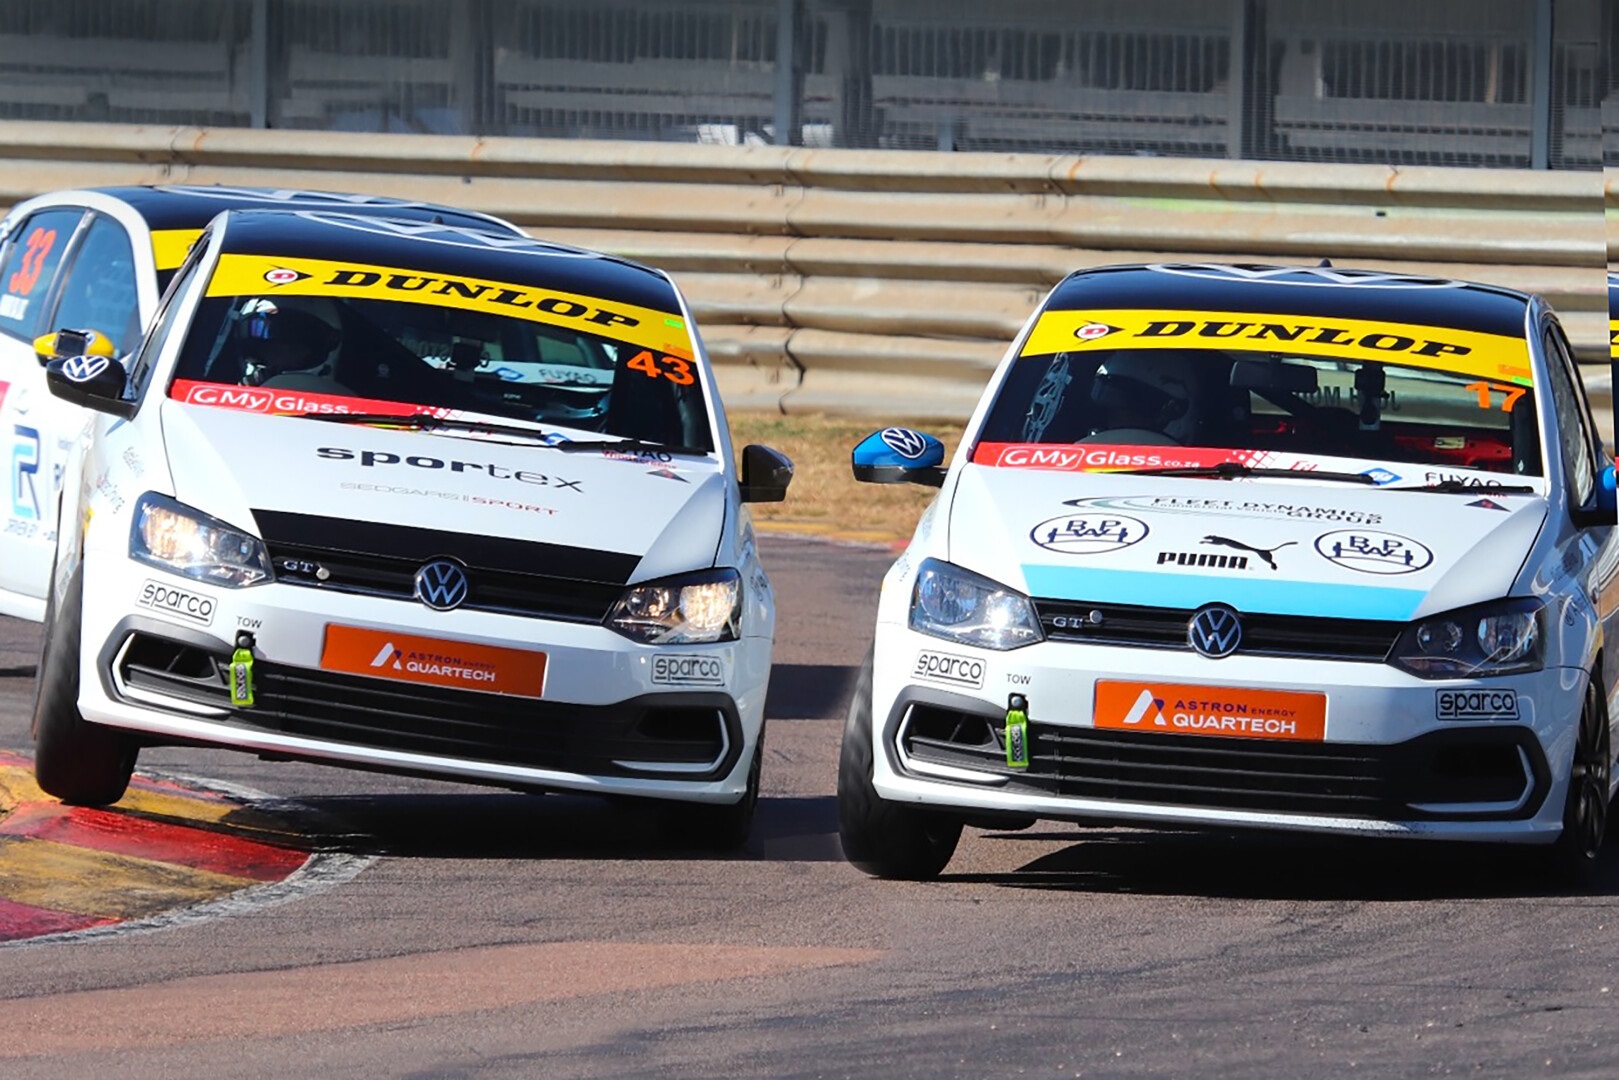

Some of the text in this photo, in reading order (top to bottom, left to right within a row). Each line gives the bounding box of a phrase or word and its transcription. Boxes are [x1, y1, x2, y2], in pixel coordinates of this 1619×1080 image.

[9, 227, 57, 296] 33
[322, 269, 640, 328] DUNLOP
[1133, 320, 1472, 358] DUNLOP
[626, 350, 695, 386] 43
[1465, 380, 1526, 412] 17
[316, 446, 585, 494] sportex
[471, 496, 559, 516] SPORT
[1154, 497, 1383, 520] FLEET DYNAMICS
[1287, 510, 1382, 525] GROUP
[1156, 552, 1249, 571] PUMA
[142, 583, 213, 618] sparco
[235, 615, 263, 630] TOW
[408, 651, 462, 665] ASTRON
[654, 655, 721, 682] sparco
[917, 653, 983, 682] sparco
[405, 661, 497, 683] QUARTECH
[1006, 673, 1032, 686] TOW
[1174, 699, 1296, 718] ASTRON ENERGY
[1439, 690, 1516, 718] sparco
[1171, 713, 1297, 735] QUARTECH
